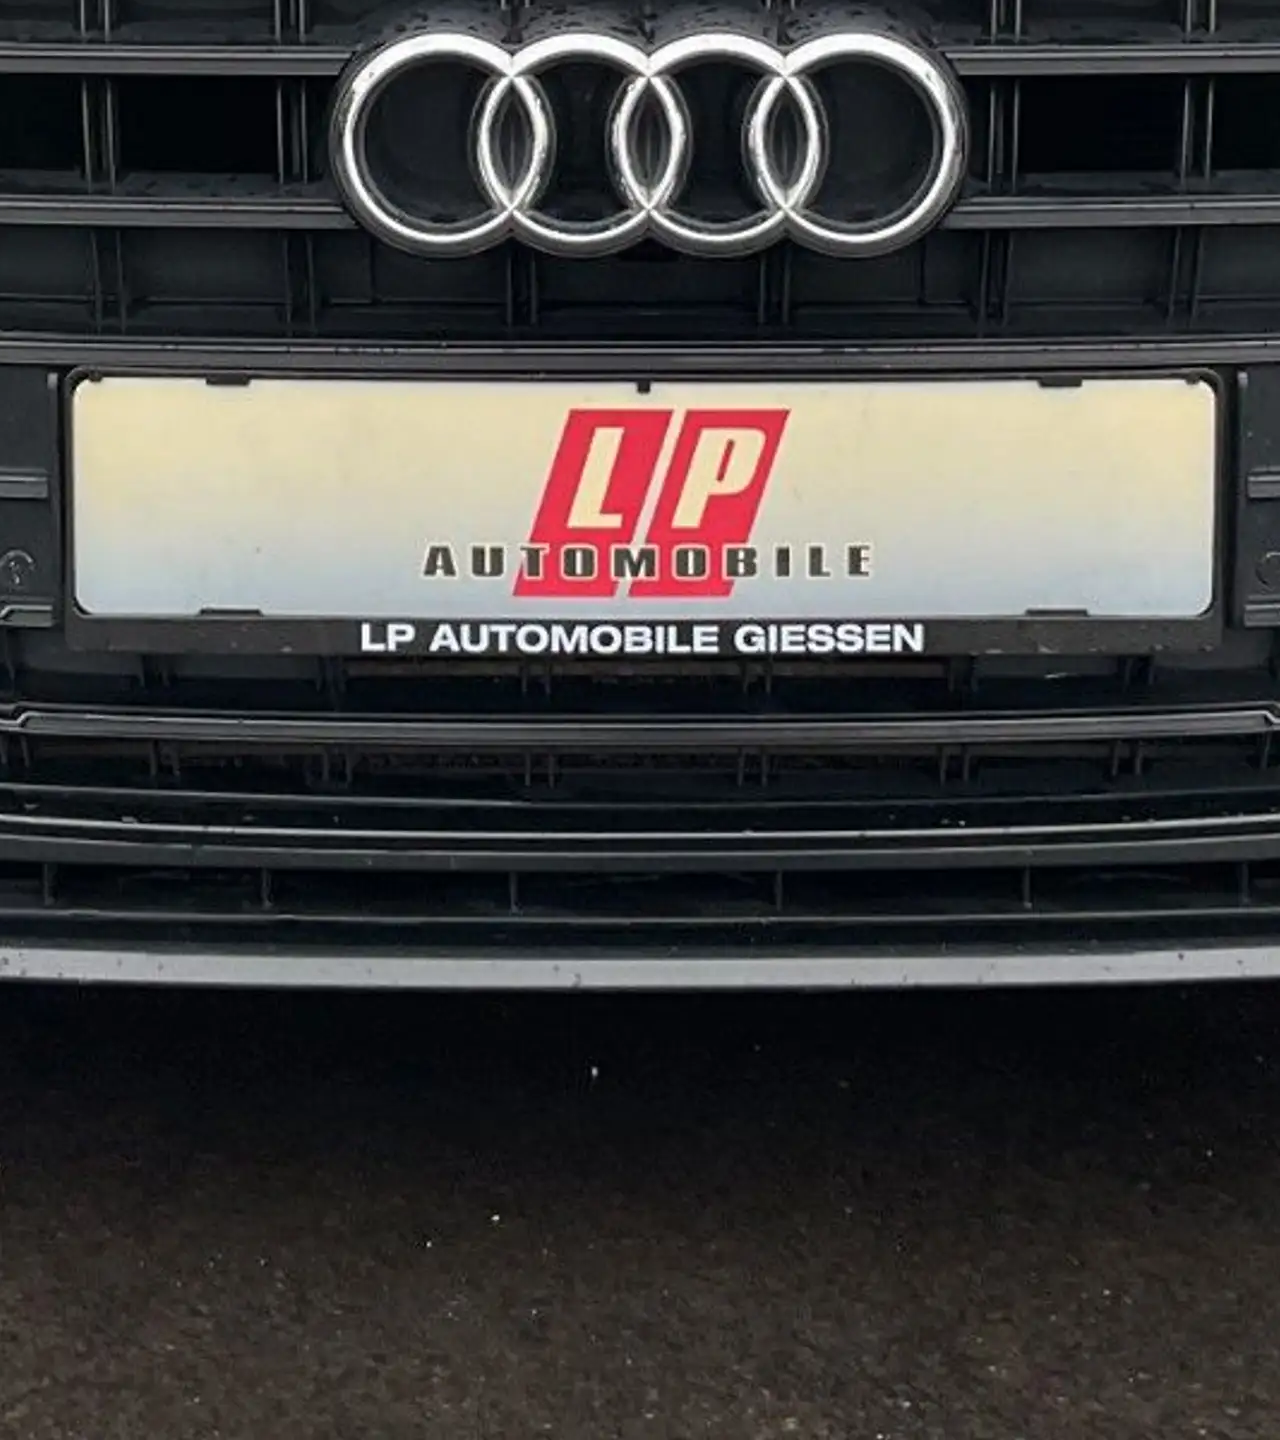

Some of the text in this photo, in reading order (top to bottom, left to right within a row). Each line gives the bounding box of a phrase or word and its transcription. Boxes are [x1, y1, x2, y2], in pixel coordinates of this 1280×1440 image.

[566, 426, 767, 529] LP
[423, 545, 873, 579] AUTOMOBILE
[360, 623, 926, 654] LP AUTOMOBILE GIESSEN
